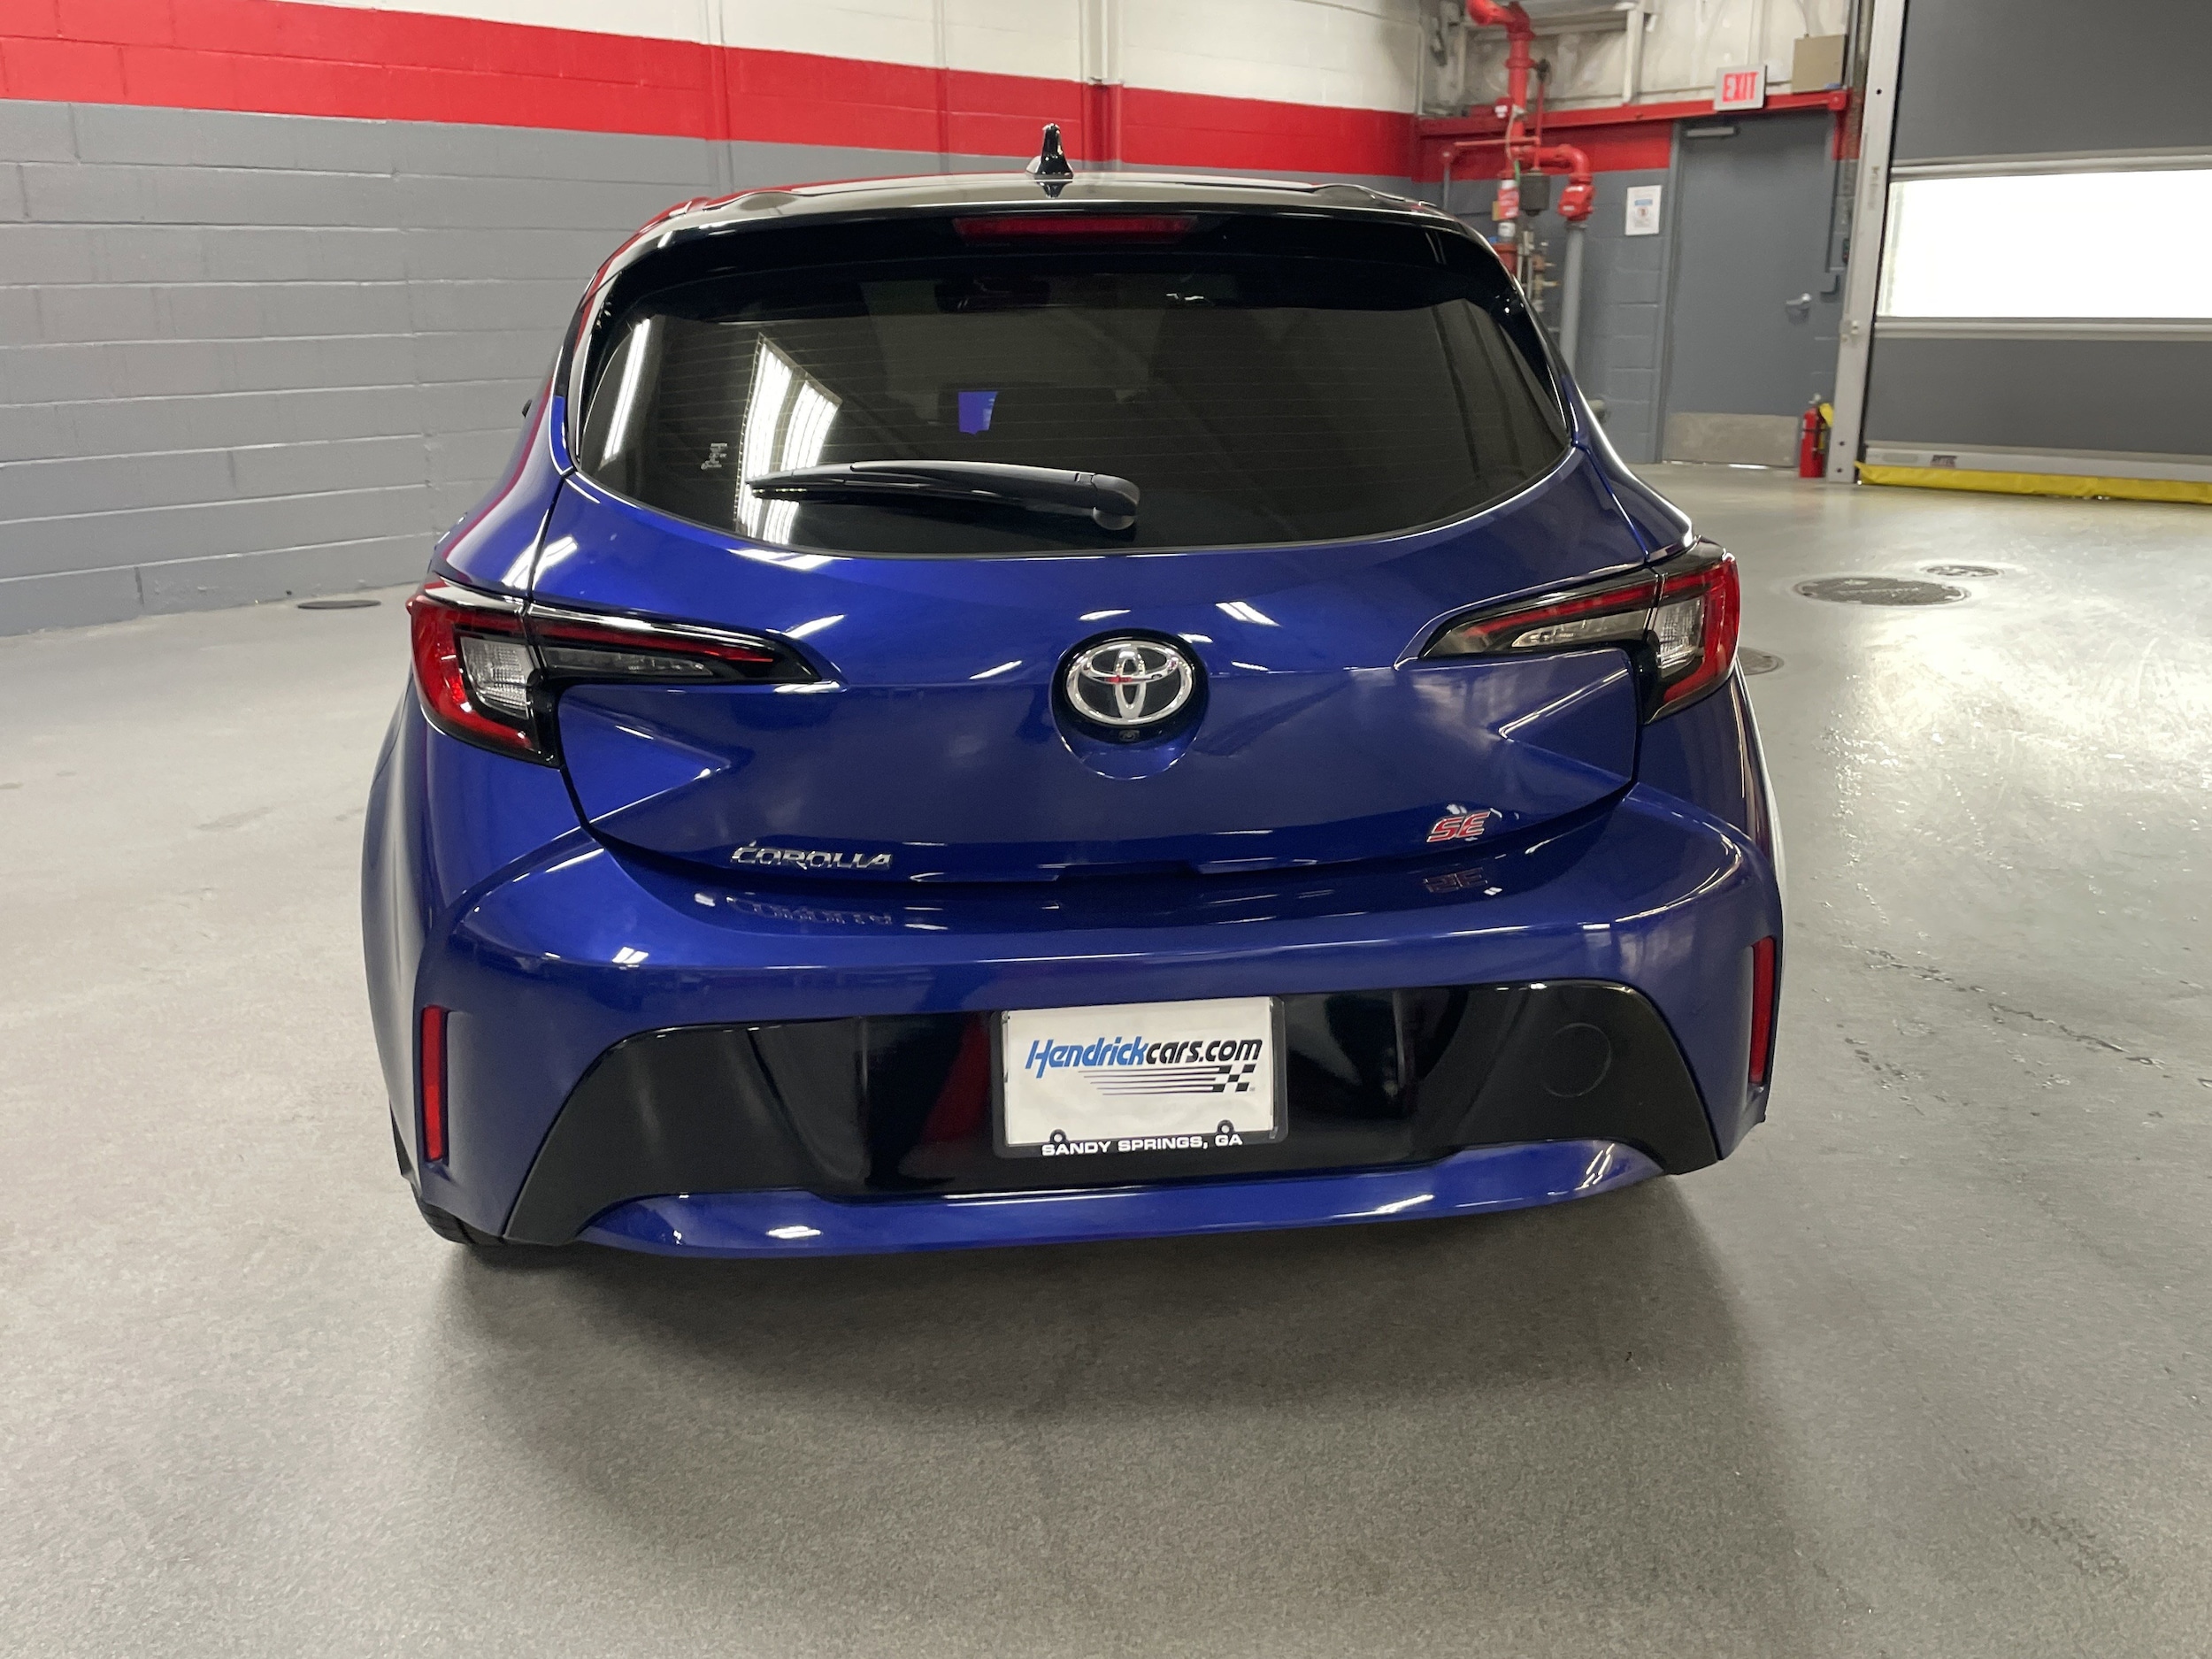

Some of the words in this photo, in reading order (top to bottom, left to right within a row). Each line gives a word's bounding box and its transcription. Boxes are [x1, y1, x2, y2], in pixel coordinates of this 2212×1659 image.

[1723, 72, 1758, 103] EXIT
[1426, 811, 1490, 842] SE
[731, 847, 892, 870] COROLLA
[1025, 1036, 1263, 1079] Hendrickcars.com
[1041, 1141, 1111, 1156] SANDY
[1118, 1135, 1209, 1152] SPRINGS,
[1215, 1133, 1243, 1147] GA
